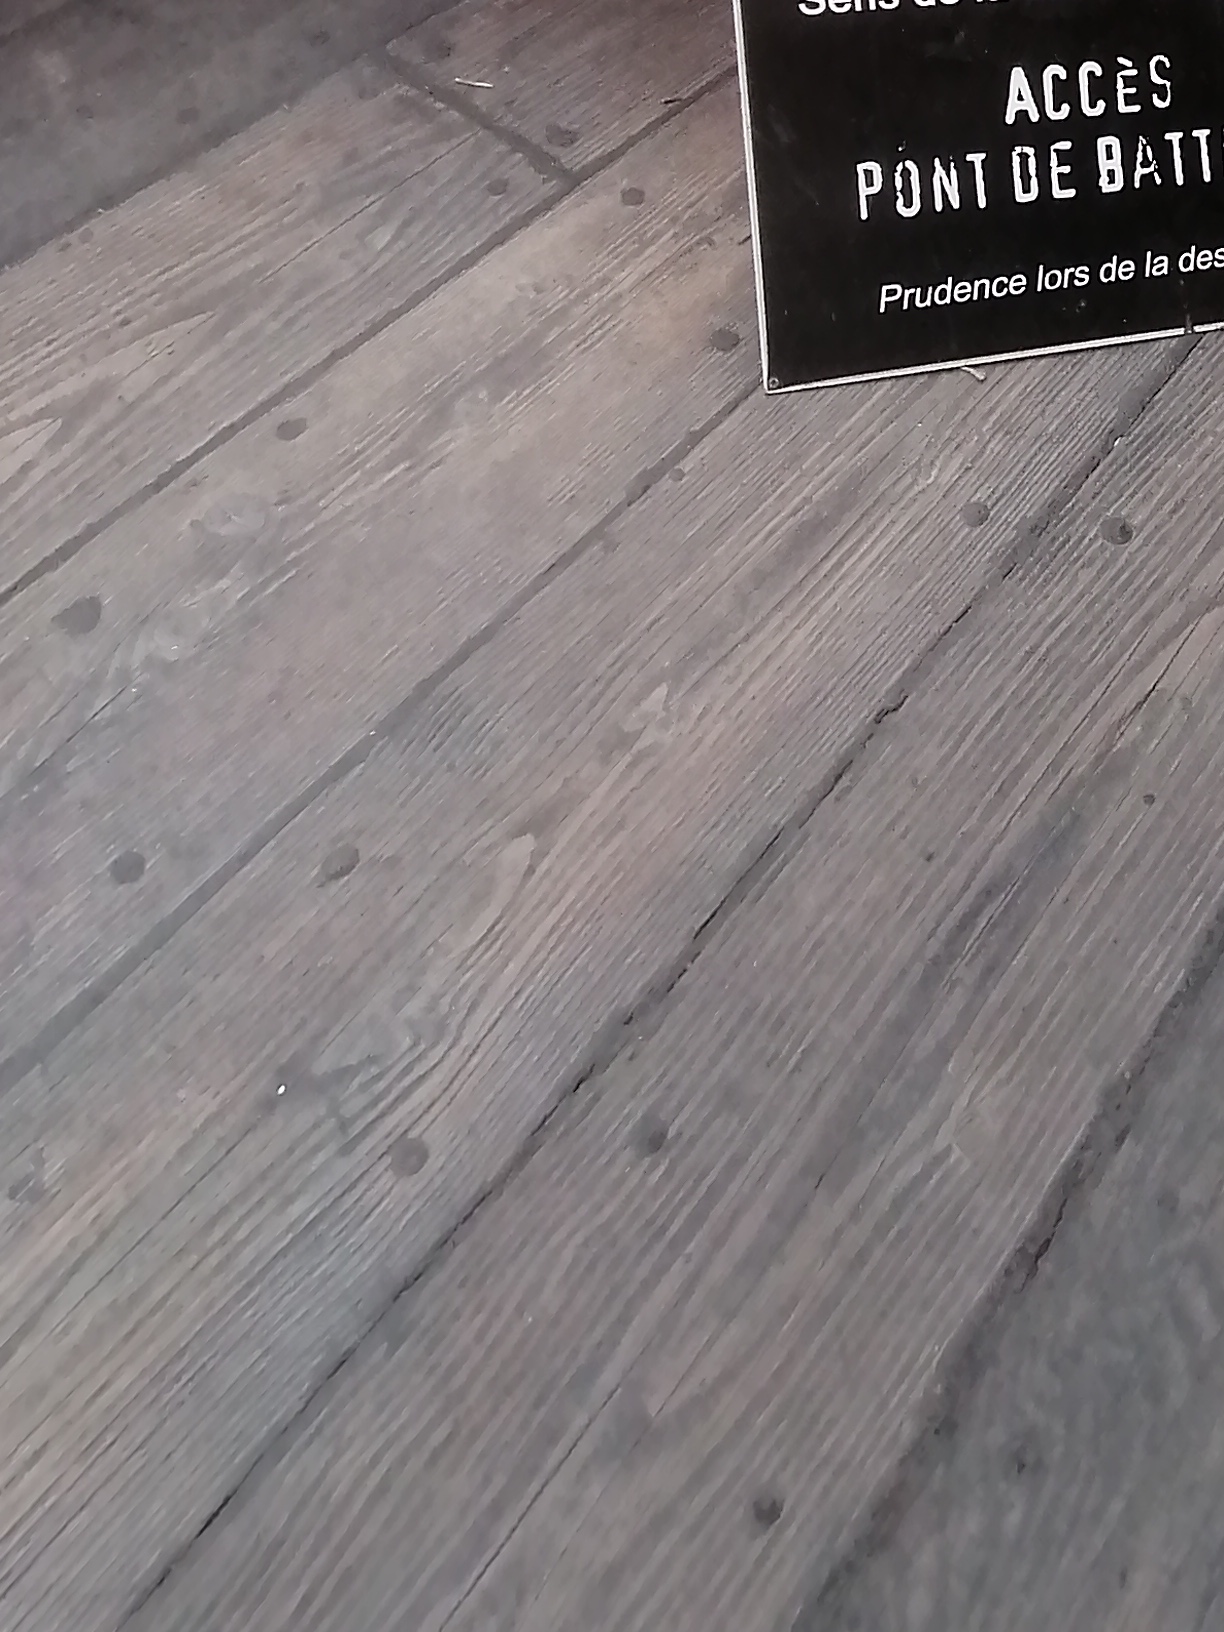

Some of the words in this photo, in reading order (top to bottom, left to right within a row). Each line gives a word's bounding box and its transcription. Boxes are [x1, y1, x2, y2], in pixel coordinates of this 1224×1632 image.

[1004, 54, 1172, 125] ACCÈS
[856, 152, 987, 221] PONT
[1011, 140, 1077, 203] DE
[879, 273, 1027, 314] Prudence
[1036, 264, 1090, 292] lors
[1099, 254, 1136, 283] de
[1144, 250, 1169, 278] la
